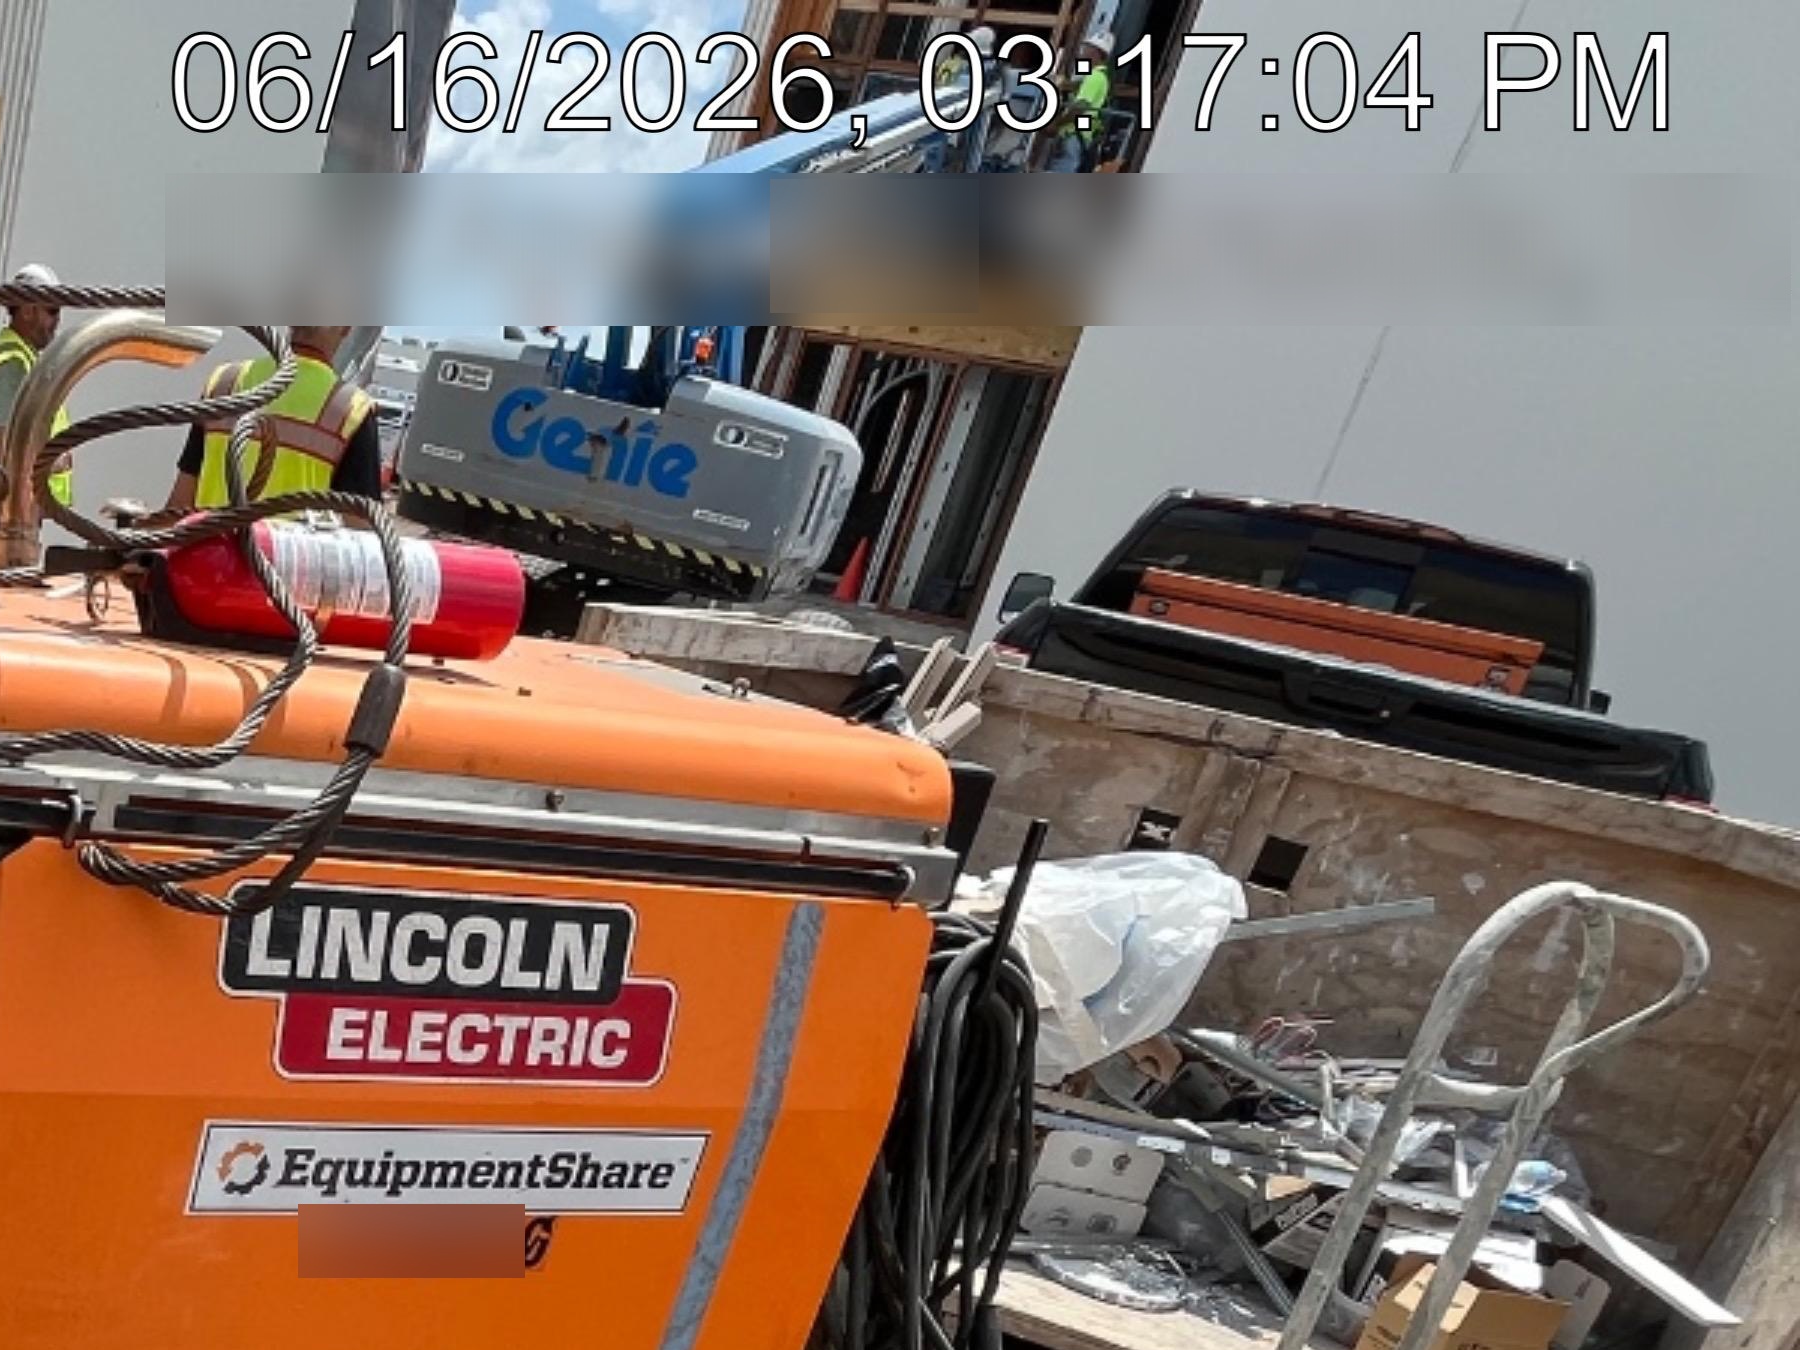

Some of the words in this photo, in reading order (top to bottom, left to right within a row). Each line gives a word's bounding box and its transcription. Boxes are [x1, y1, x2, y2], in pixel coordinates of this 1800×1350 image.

[246, 905, 610, 991] LINCOLN
[326, 1008, 631, 1068] ELECTRIC
[276, 1148, 675, 1196] EquipmentShare
